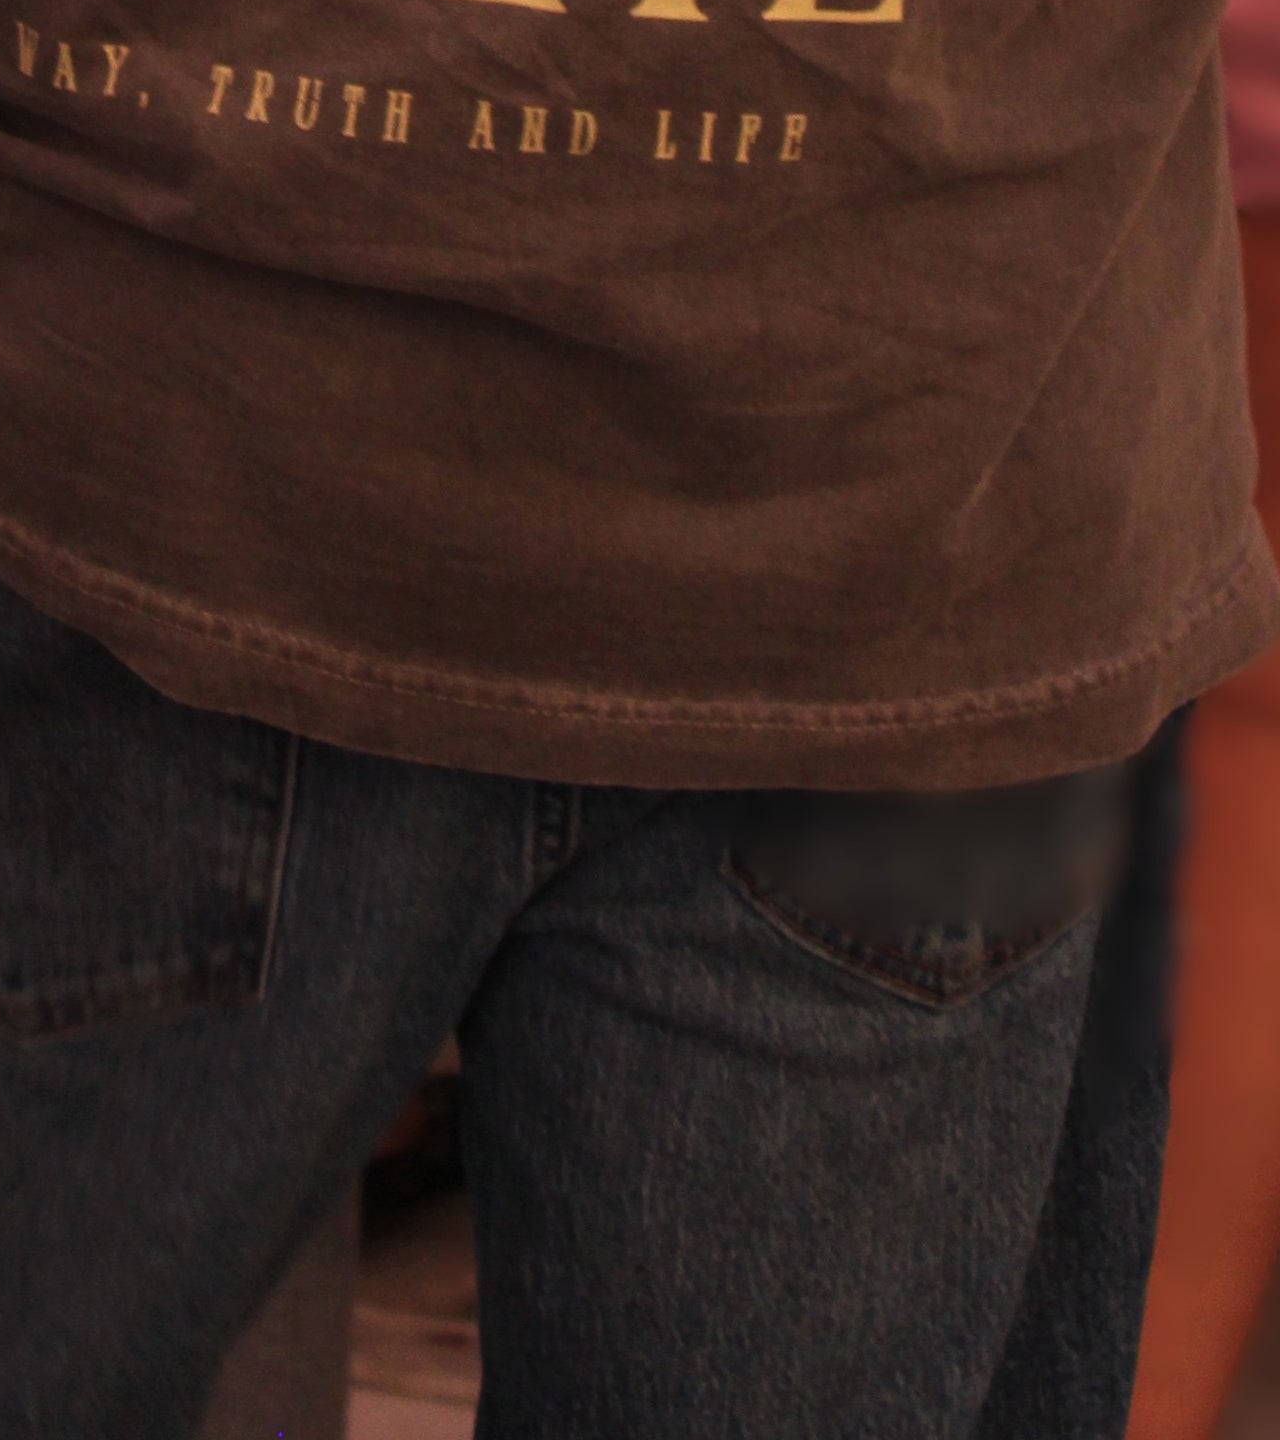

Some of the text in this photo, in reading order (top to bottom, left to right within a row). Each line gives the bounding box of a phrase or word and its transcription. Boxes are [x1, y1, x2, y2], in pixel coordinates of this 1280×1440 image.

[15, 20, 809, 164] WAY, TRUTH AND LIFE
